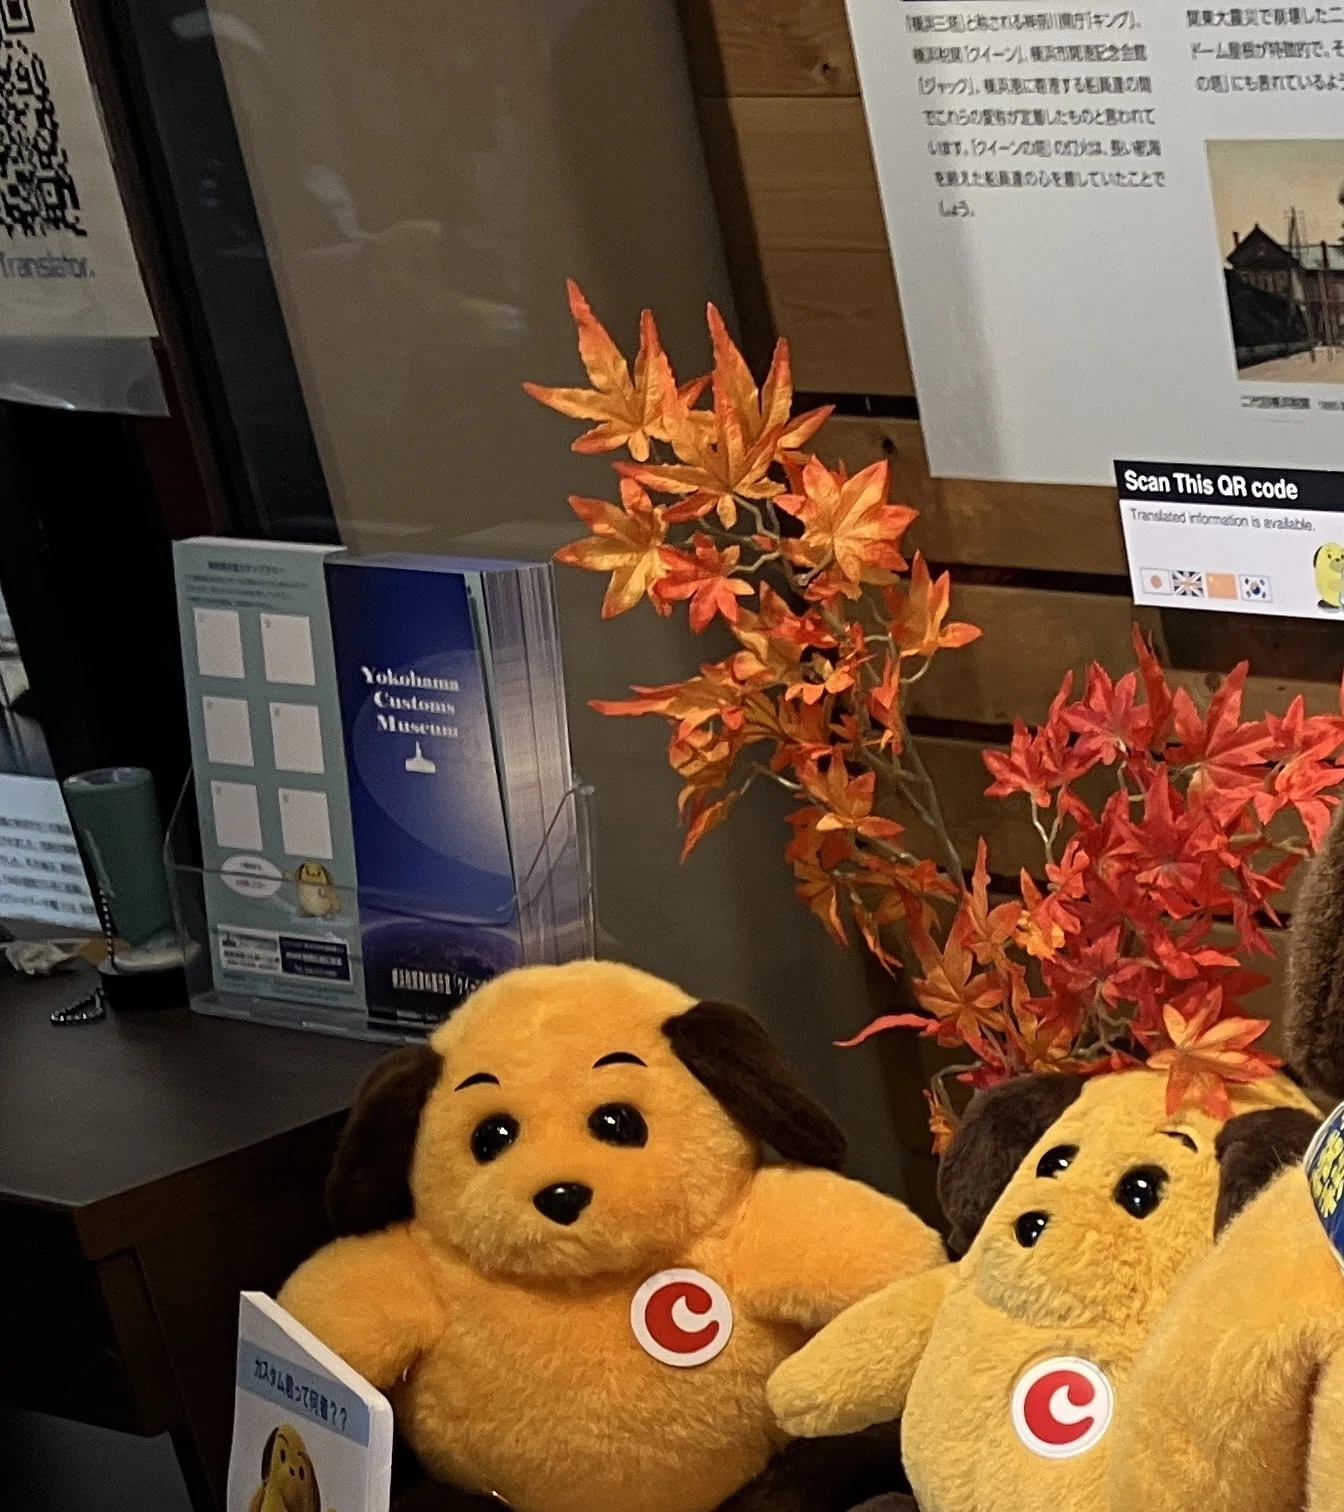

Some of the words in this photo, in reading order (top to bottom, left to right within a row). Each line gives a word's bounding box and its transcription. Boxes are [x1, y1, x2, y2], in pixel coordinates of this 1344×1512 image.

[1124, 469, 1170, 493] Scan
[1173, 473, 1214, 496] This
[1217, 476, 1248, 500] QR
[1251, 479, 1298, 500] code
[1252, 514, 1262, 529] is
[361, 666, 459, 693] Yokohama
[373, 691, 457, 715] Customs
[376, 714, 460, 739] Museum
